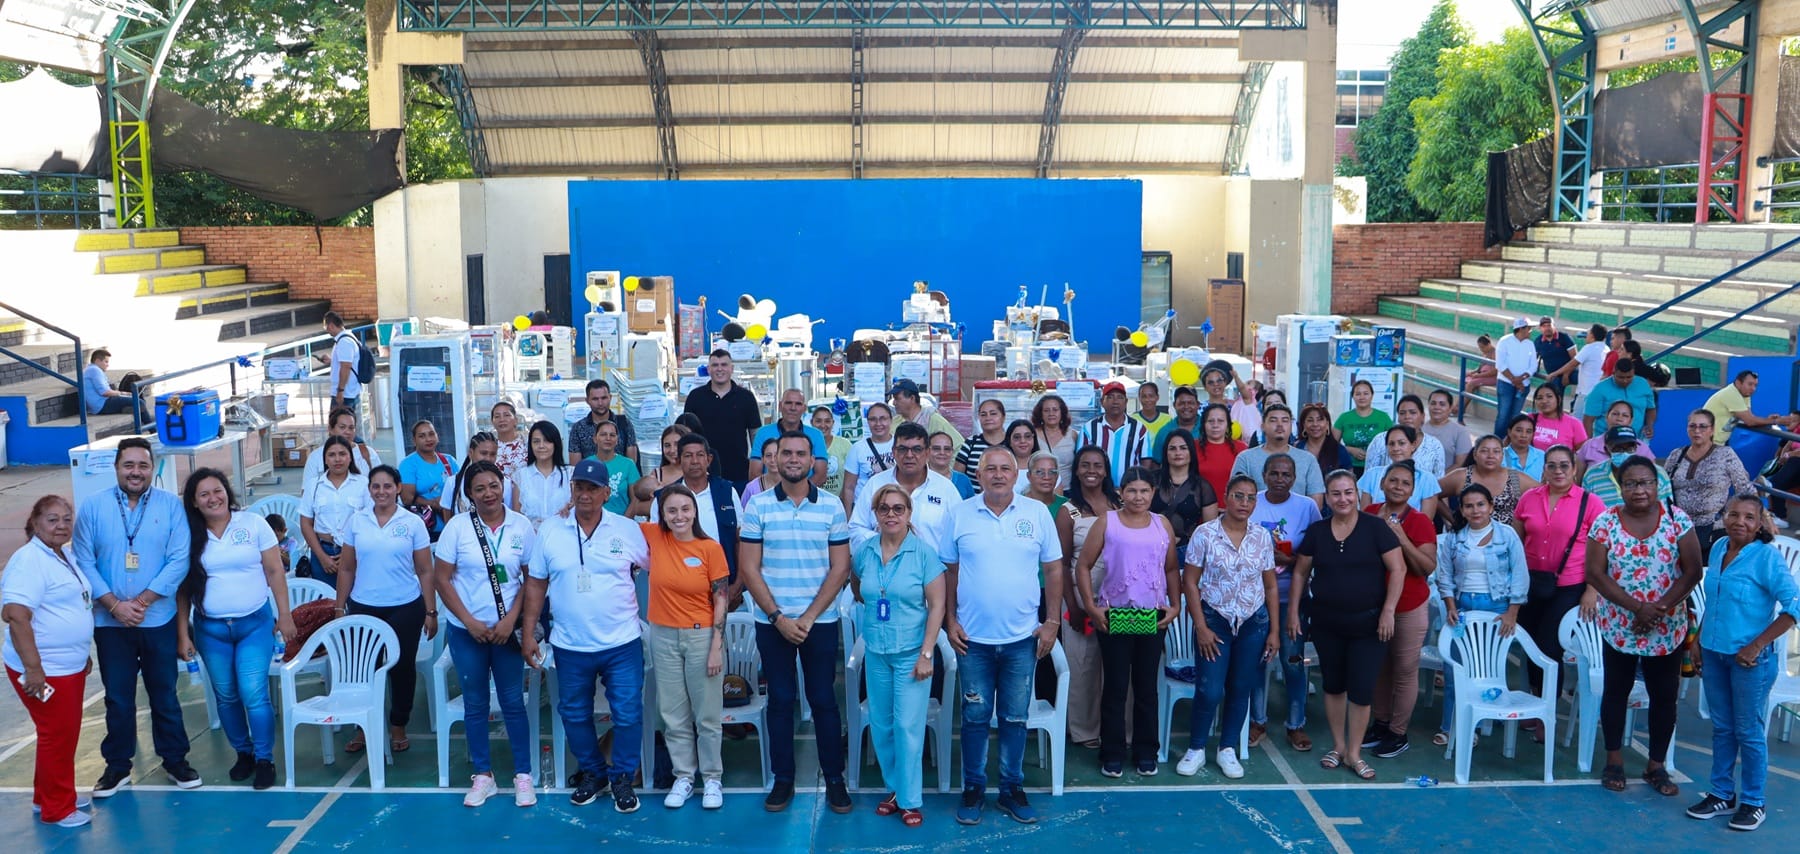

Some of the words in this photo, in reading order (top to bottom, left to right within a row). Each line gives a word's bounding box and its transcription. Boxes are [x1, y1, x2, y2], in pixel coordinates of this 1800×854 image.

[473, 516, 484, 538] COACH
[482, 544, 494, 567] COACH
[491, 573, 501, 595] COACH
